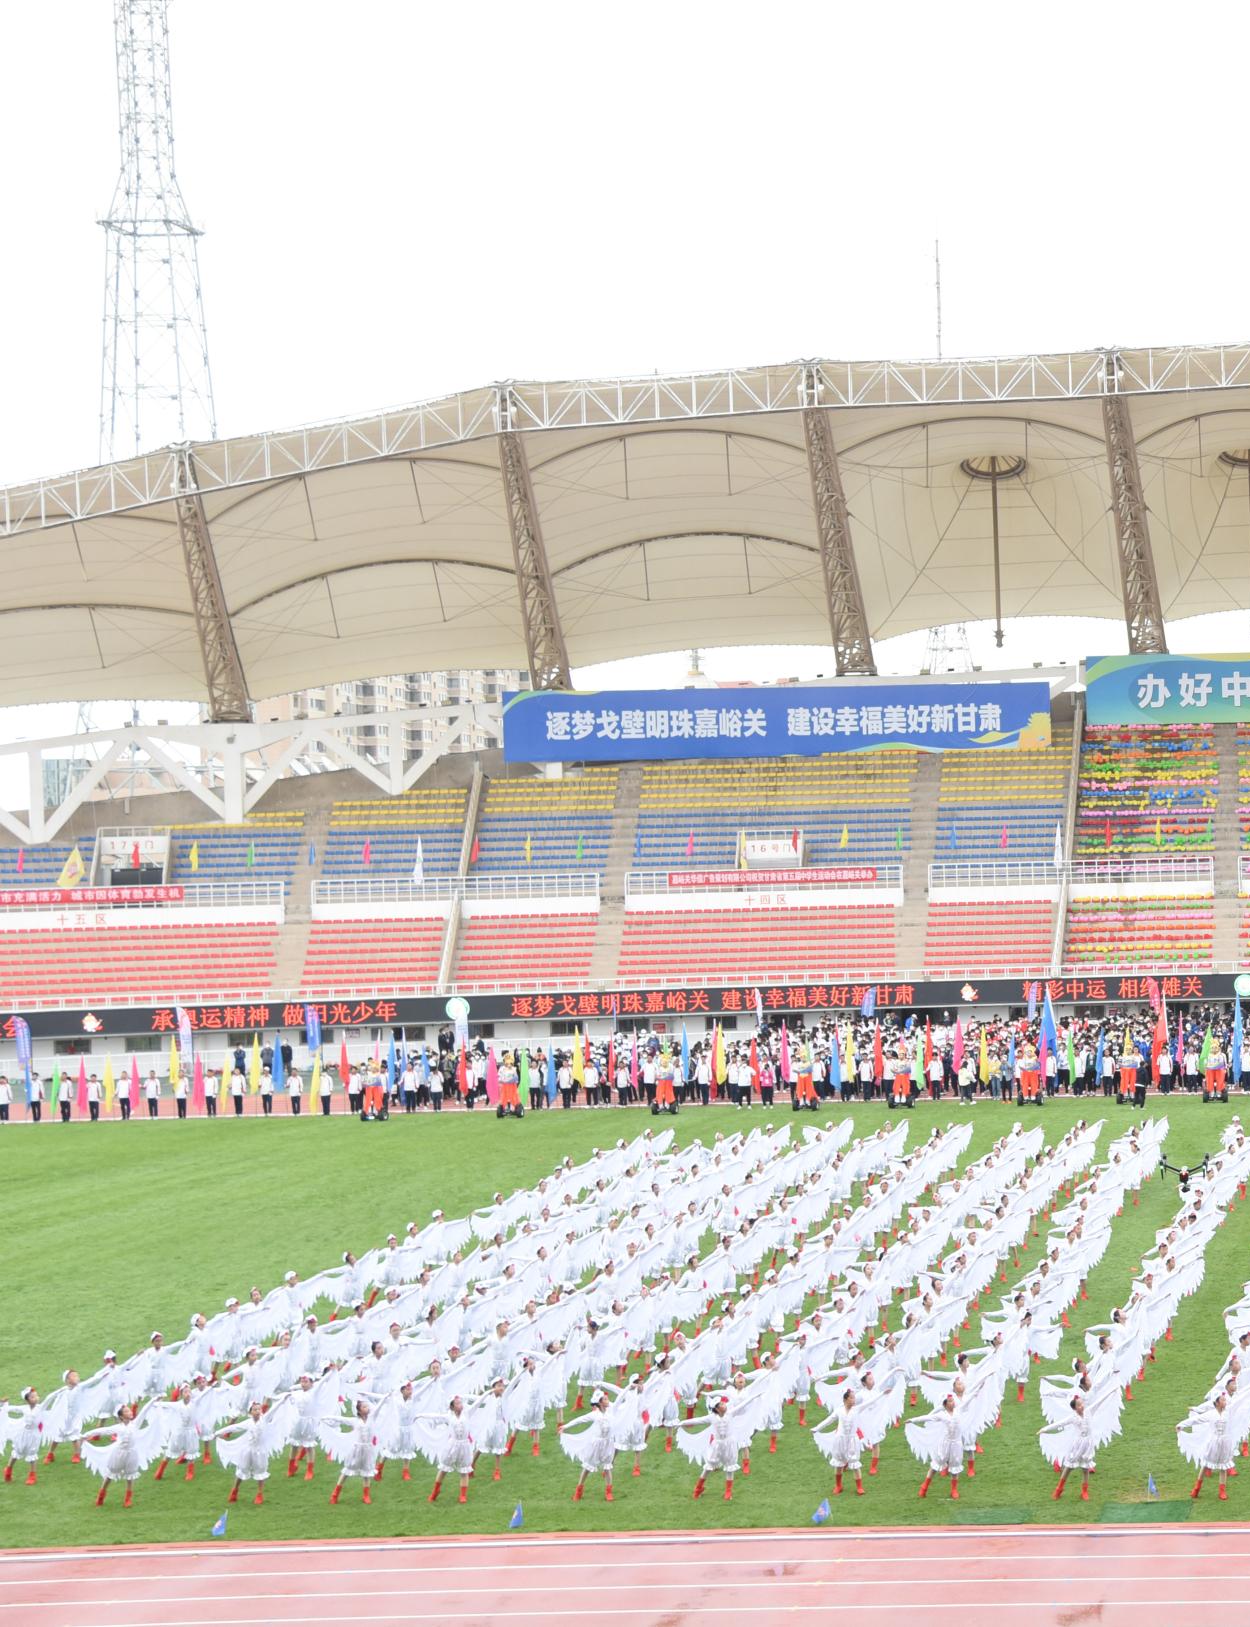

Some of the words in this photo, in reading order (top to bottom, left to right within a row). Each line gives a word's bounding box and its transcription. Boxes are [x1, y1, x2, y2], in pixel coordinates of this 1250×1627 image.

[546, 708, 767, 741] 逐梦戈壁明珠嘉峪关
[787, 702, 1002, 736] 建设幸福美好新甘肃
[110, 840, 154, 849] 17门
[744, 894, 787, 906] 十四区
[57, 912, 107, 926] 十五区
[511, 988, 709, 1017] 逐梦戈壁明珠嘉峪关
